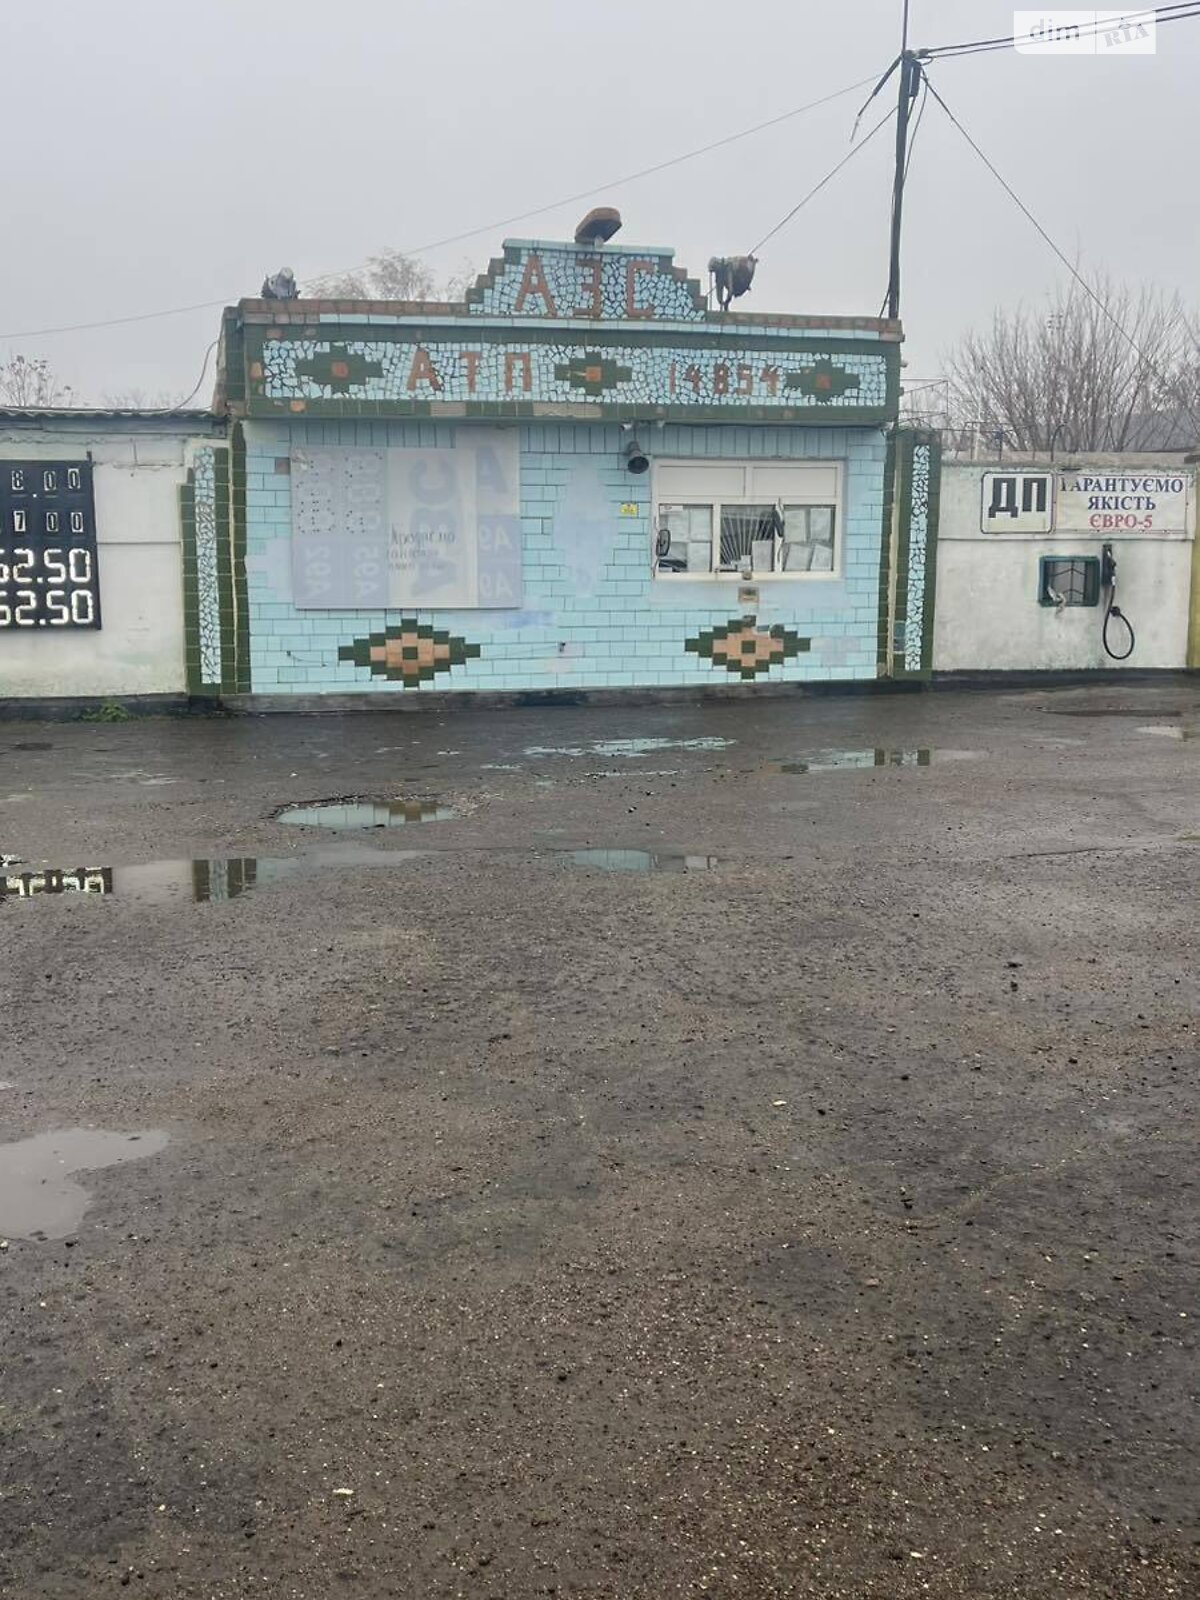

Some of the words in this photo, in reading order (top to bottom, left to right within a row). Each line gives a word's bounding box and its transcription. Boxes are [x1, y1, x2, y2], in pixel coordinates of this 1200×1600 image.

[515, 254, 655, 319] АЗС
[407, 347, 533, 393] АТП
[669, 359, 781, 397] 14854
[988, 477, 1047, 518] ДП
[1088, 496, 1157, 511] ЯКІСТЬ
[1089, 514, 1153, 529] ЄВРО-5
